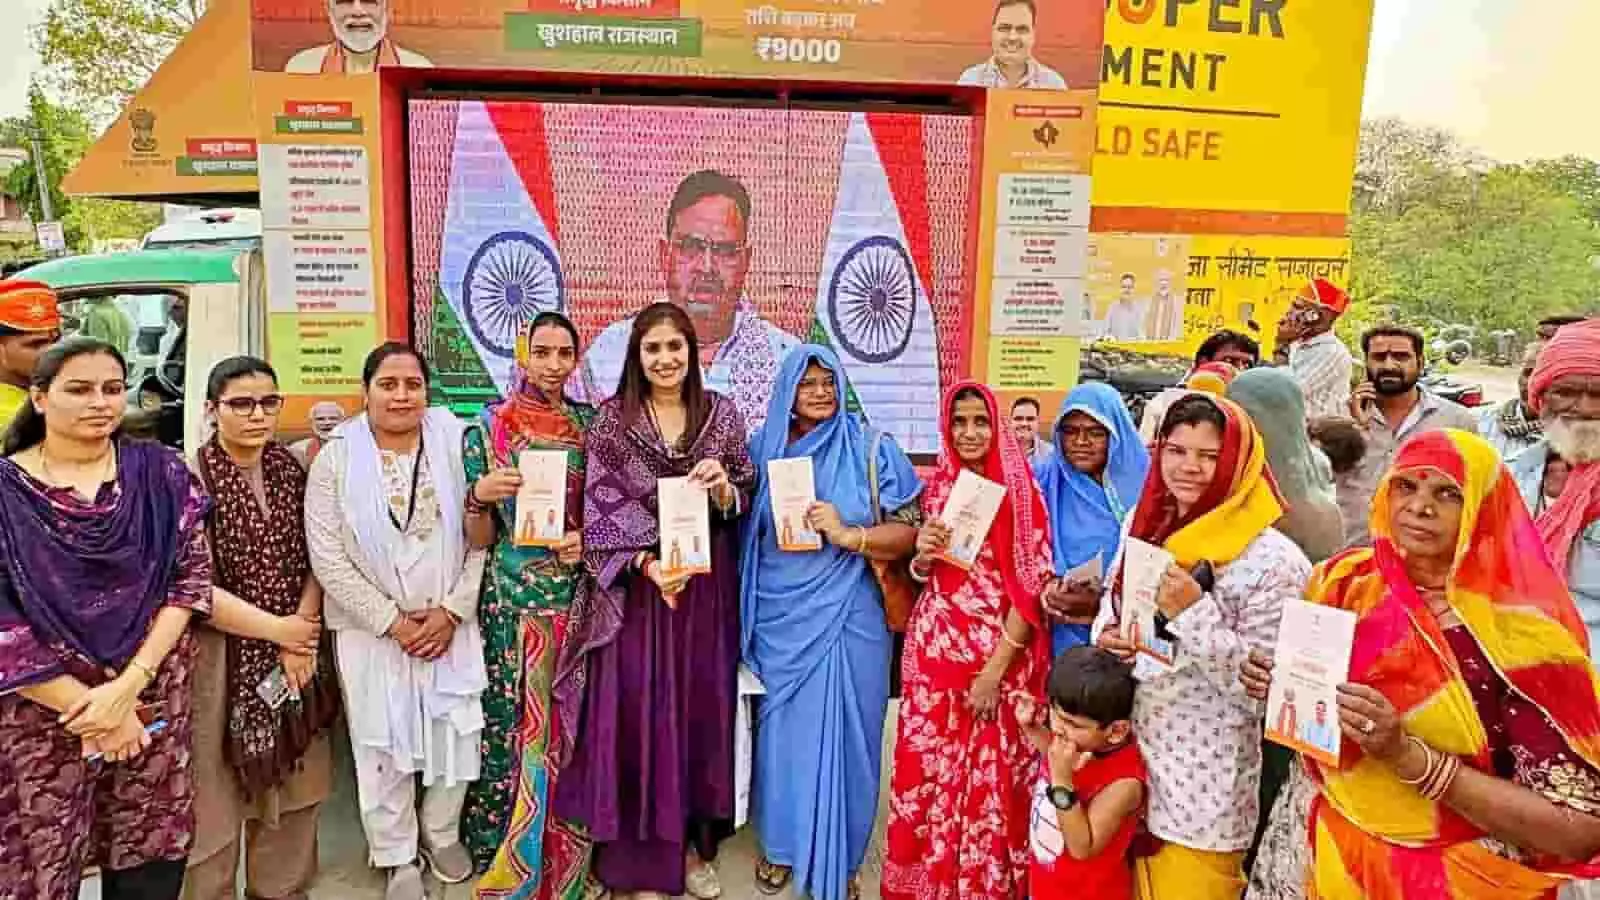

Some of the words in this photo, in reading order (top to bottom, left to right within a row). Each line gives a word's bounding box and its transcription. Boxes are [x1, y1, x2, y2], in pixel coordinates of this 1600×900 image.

[536, 23, 604, 48] खुशहाल
[606, 26, 680, 46] राजस्थान
[757, 37, 841, 63] ₹9000
[1102, 44, 1227, 92] MENT
[1141, 126, 1223, 161] SAFE
